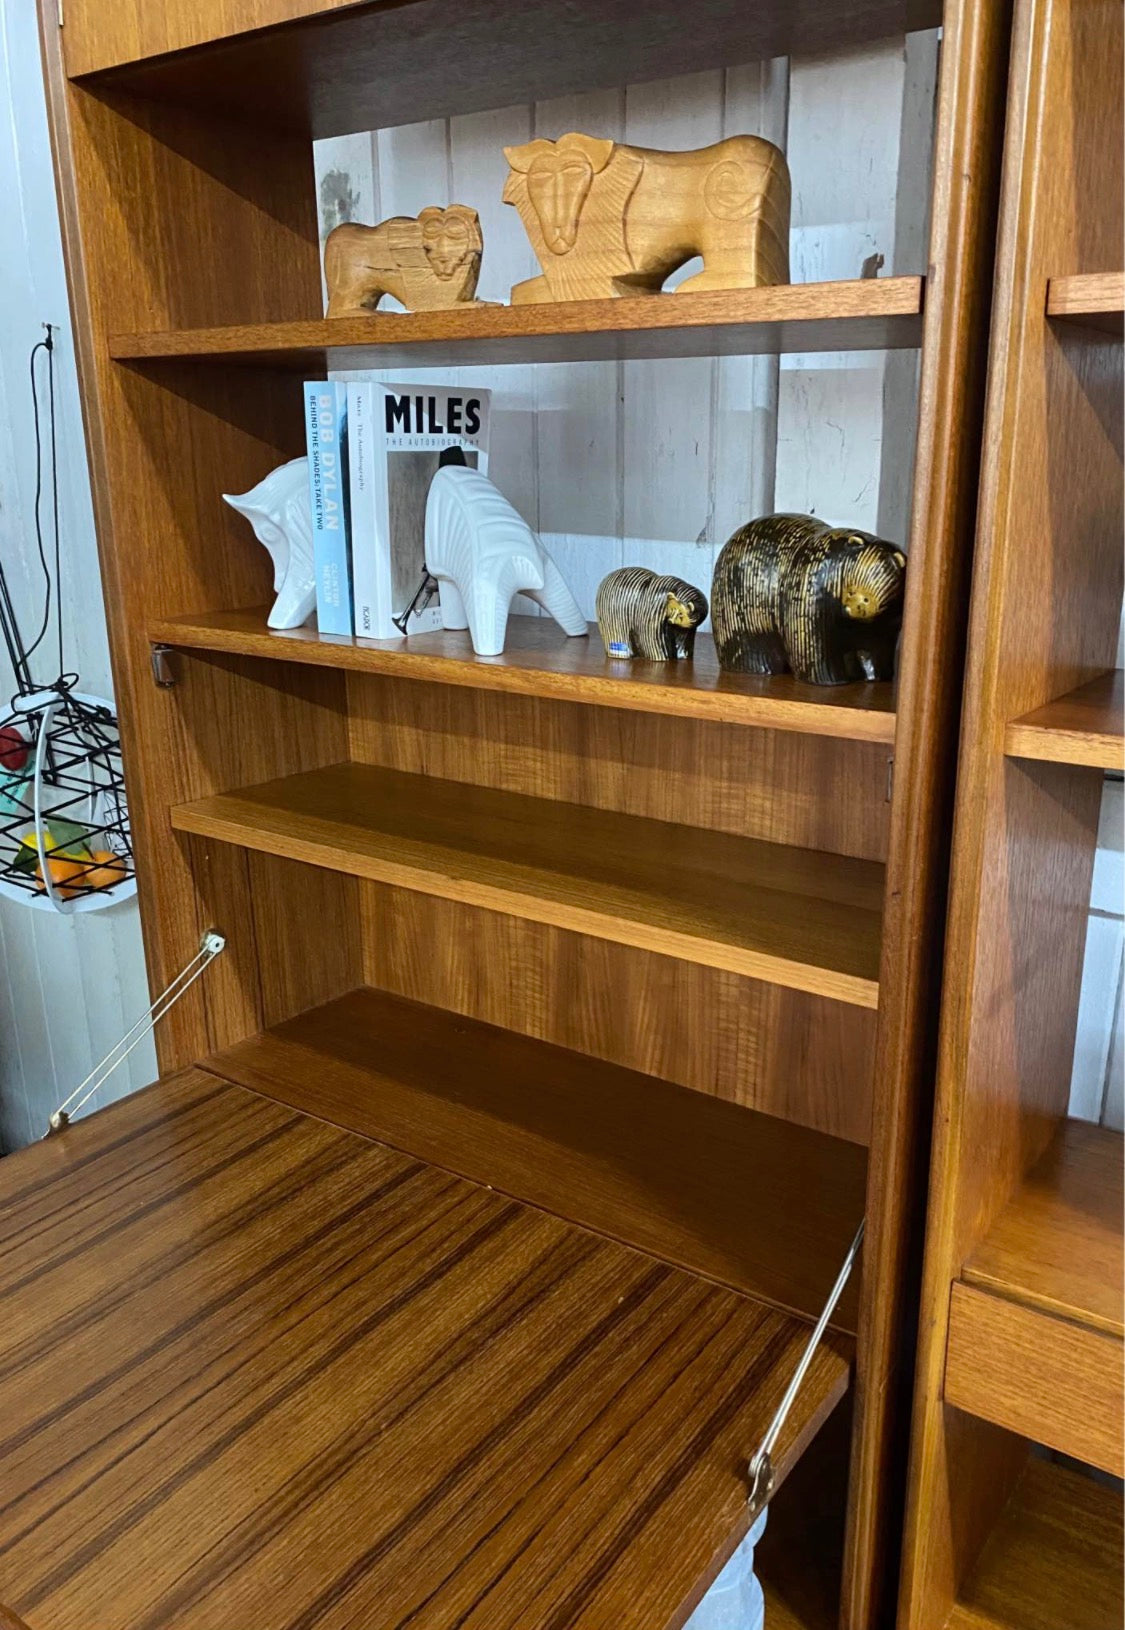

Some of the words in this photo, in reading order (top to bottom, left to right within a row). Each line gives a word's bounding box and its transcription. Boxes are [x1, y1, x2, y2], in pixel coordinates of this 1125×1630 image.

[310, 395, 318, 429] BEHIND
[319, 394, 334, 443] BOB
[385, 394, 481, 435] MILES
[386, 438, 403, 446] THE
[409, 438, 480, 446] AUTOBIOGRAPHY
[322, 452, 339, 530] DYLAN
